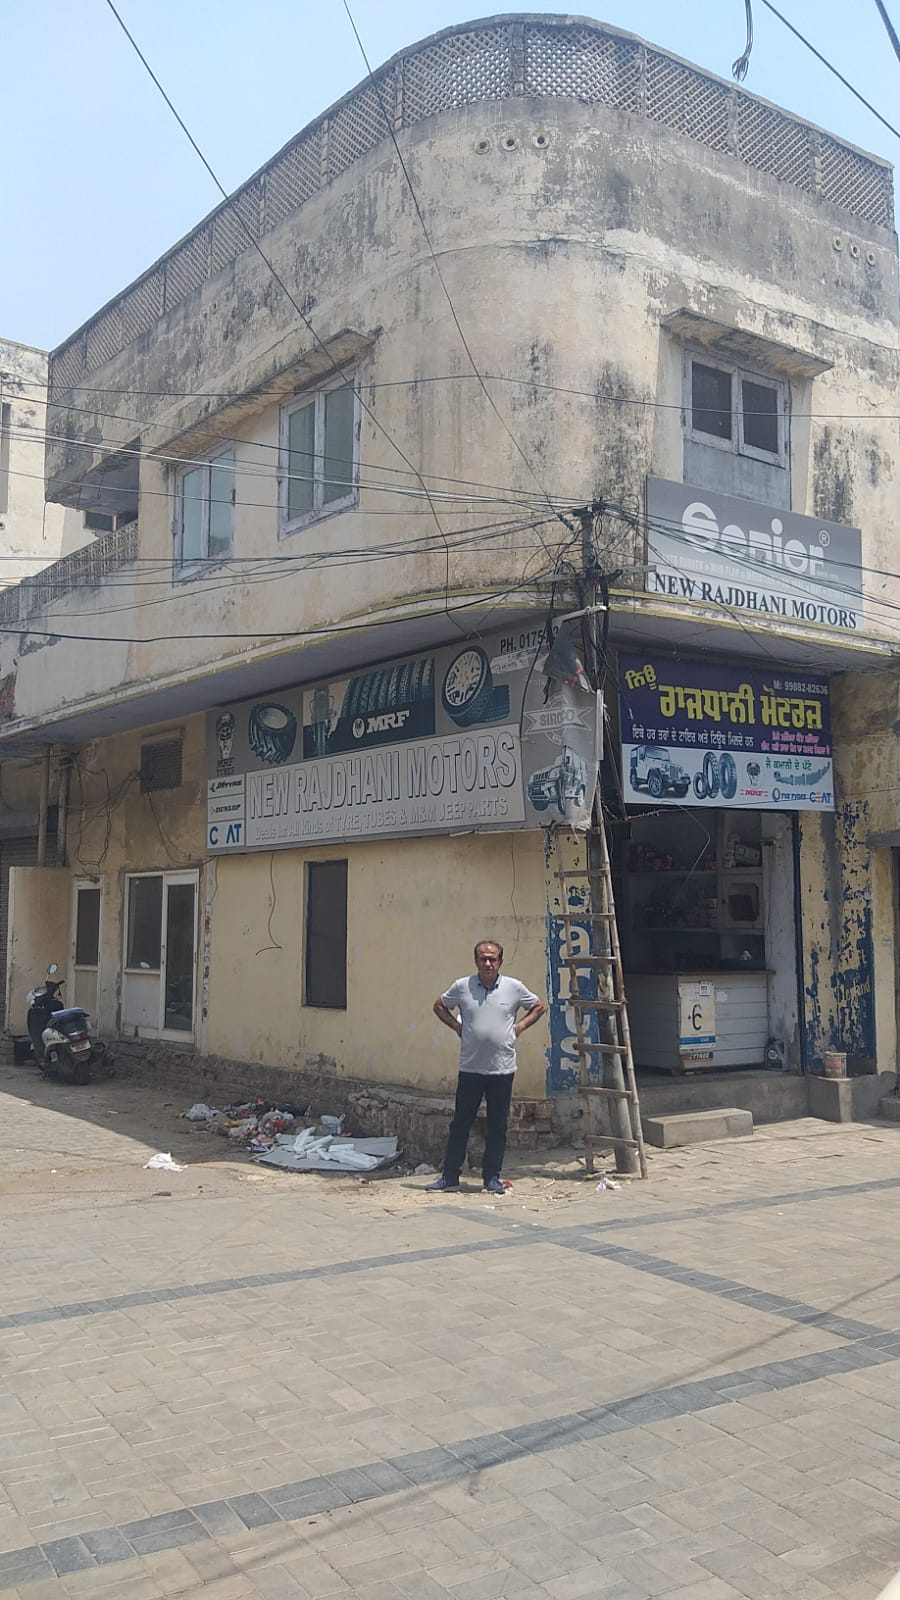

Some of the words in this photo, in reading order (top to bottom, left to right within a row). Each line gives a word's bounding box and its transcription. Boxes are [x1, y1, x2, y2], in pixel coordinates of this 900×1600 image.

[682, 502, 825, 576] Senior
[655, 573, 696, 599] NEW
[702, 581, 787, 616] RAJDHANI
[791, 600, 857, 629] MOTORS
[500, 637, 516, 653] PH.
[366, 709, 410, 733] MRF
[658, 683, 756, 725] ਰਾਜਧਾਨੀ
[250, 771, 290, 819] NEW
[294, 751, 400, 813] RAJDHANI
[407, 732, 516, 798] MOTORS
[209, 824, 242, 845] CAT
